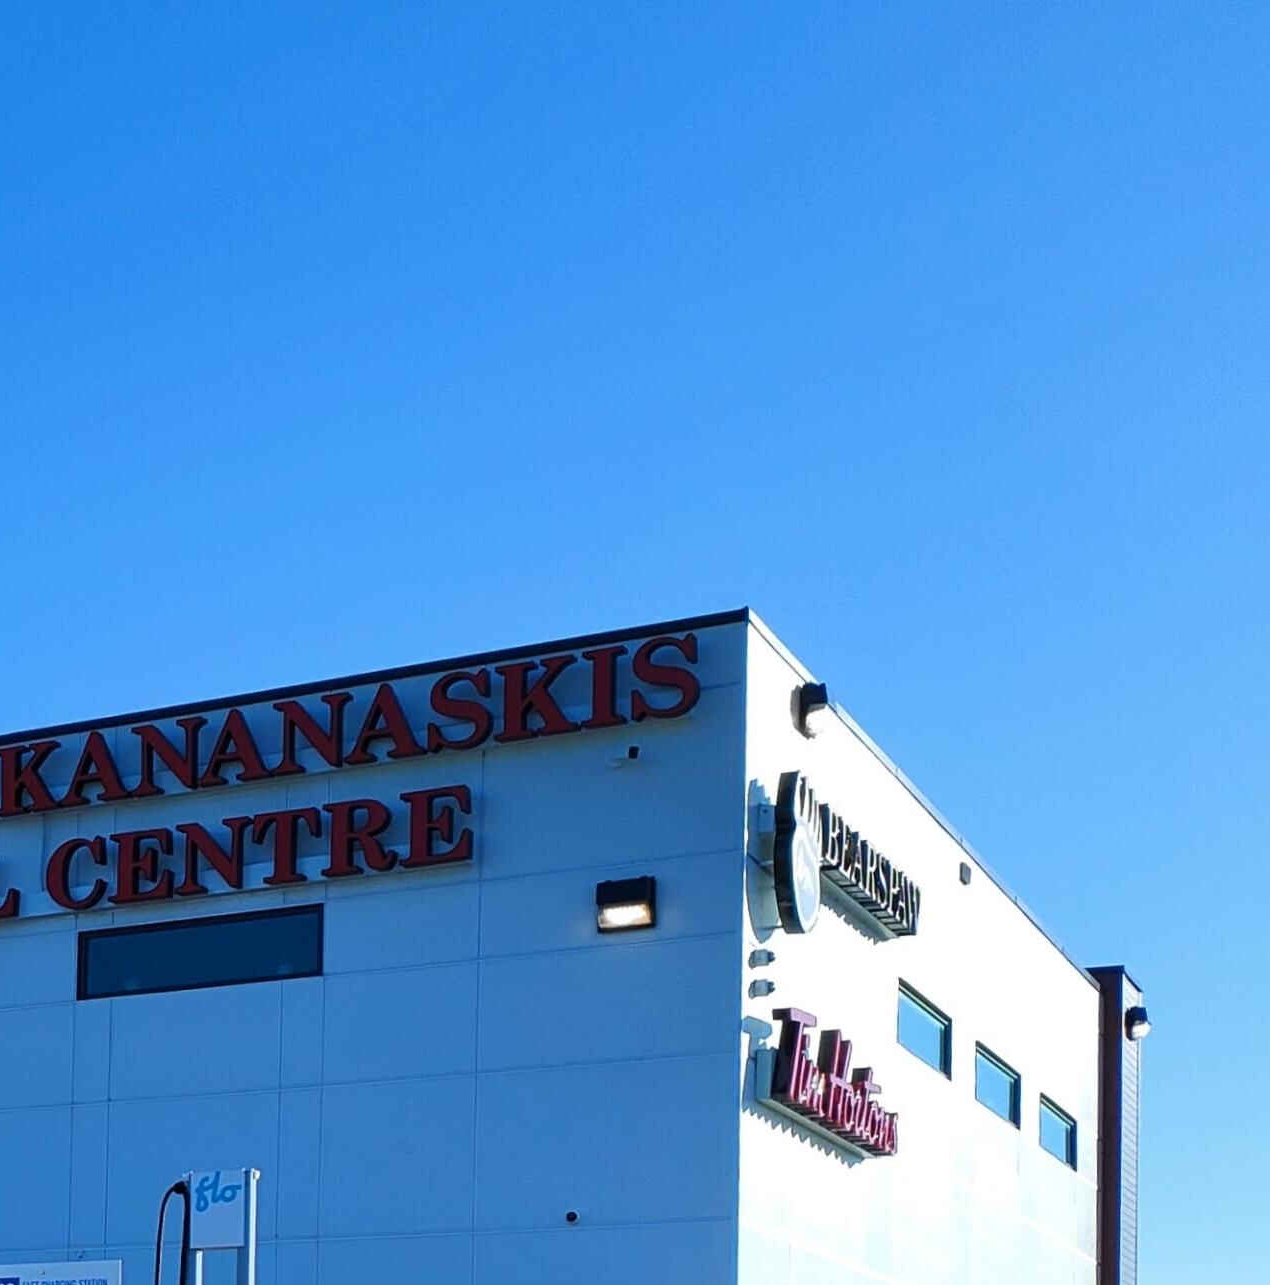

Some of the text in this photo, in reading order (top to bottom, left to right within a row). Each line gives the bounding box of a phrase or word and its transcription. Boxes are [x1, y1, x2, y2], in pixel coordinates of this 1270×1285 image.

[46, 784, 473, 910] CENTRE
[820, 802, 920, 935] BEARSPAW
[773, 1008, 898, 1156] Tim Hortons
[196, 1171, 242, 1212] flo
